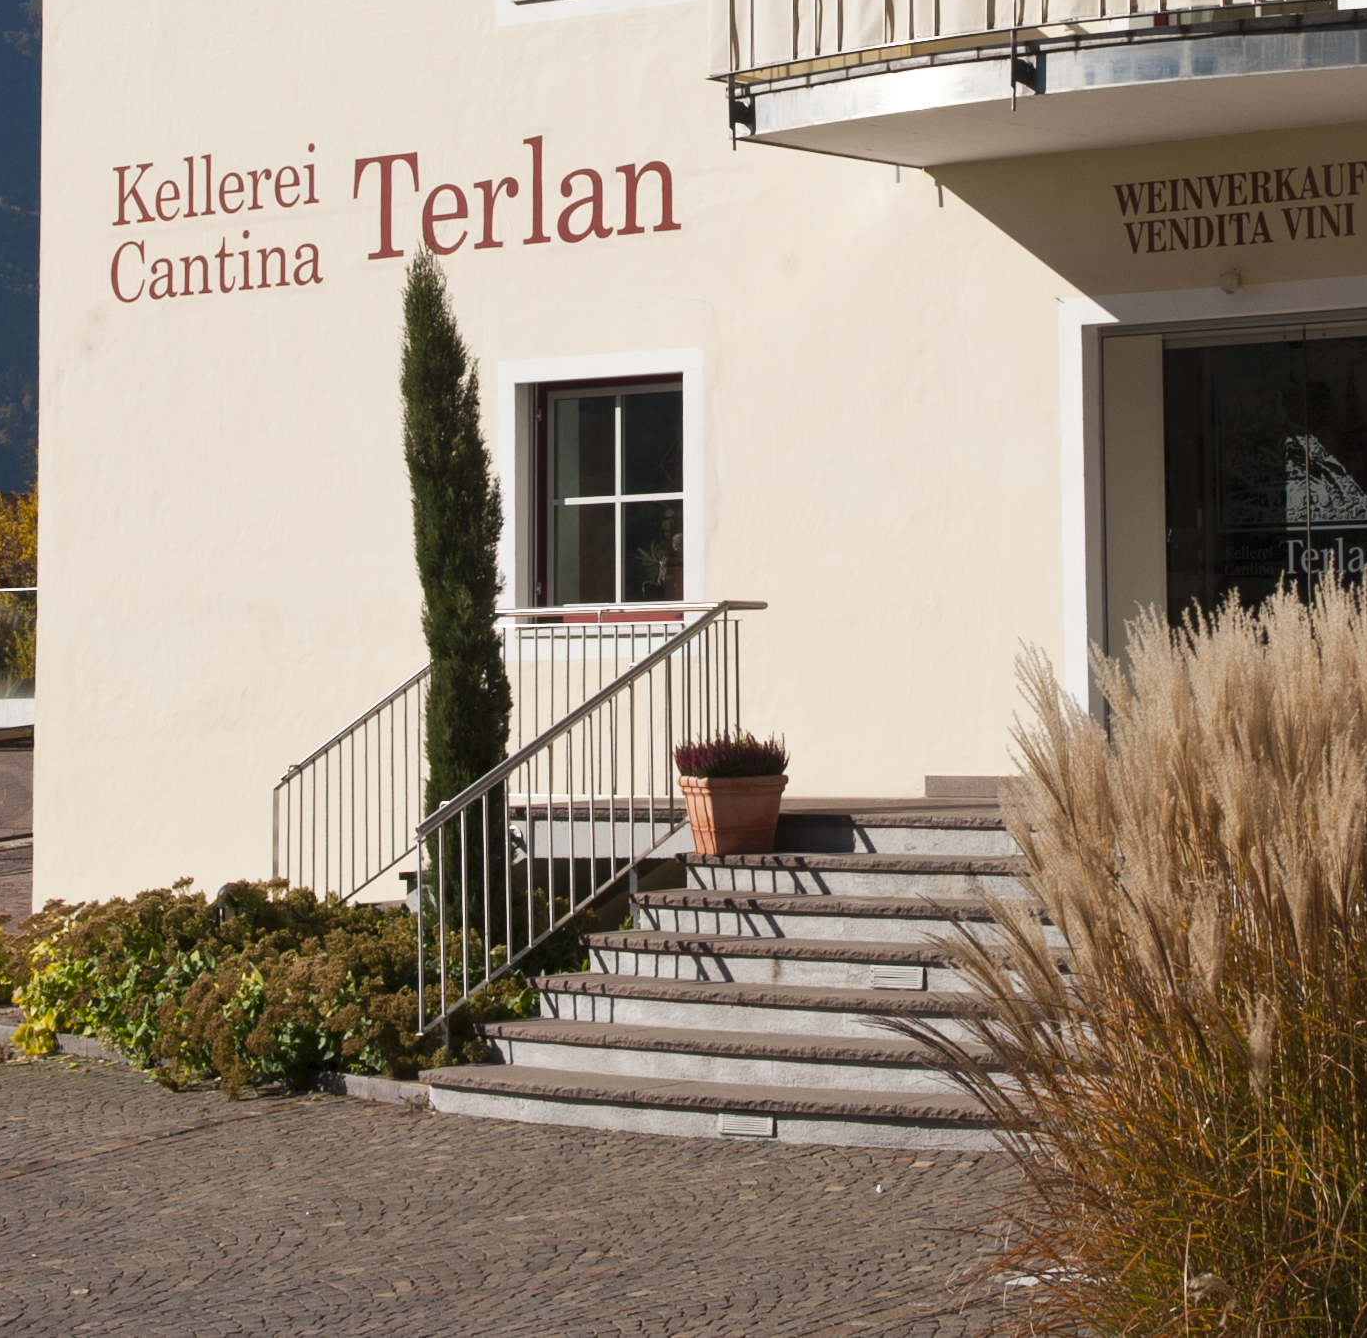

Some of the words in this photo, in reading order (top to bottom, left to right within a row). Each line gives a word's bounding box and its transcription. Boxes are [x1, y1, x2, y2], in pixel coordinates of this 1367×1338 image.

[112, 143, 320, 226] Kellerei
[353, 135, 682, 260] Terlan
[1113, 160, 1367, 217] WEINVERKAUF
[1123, 211, 1275, 254] VENDITA
[1280, 203, 1356, 241] VINI
[110, 230, 324, 303] Cantina
